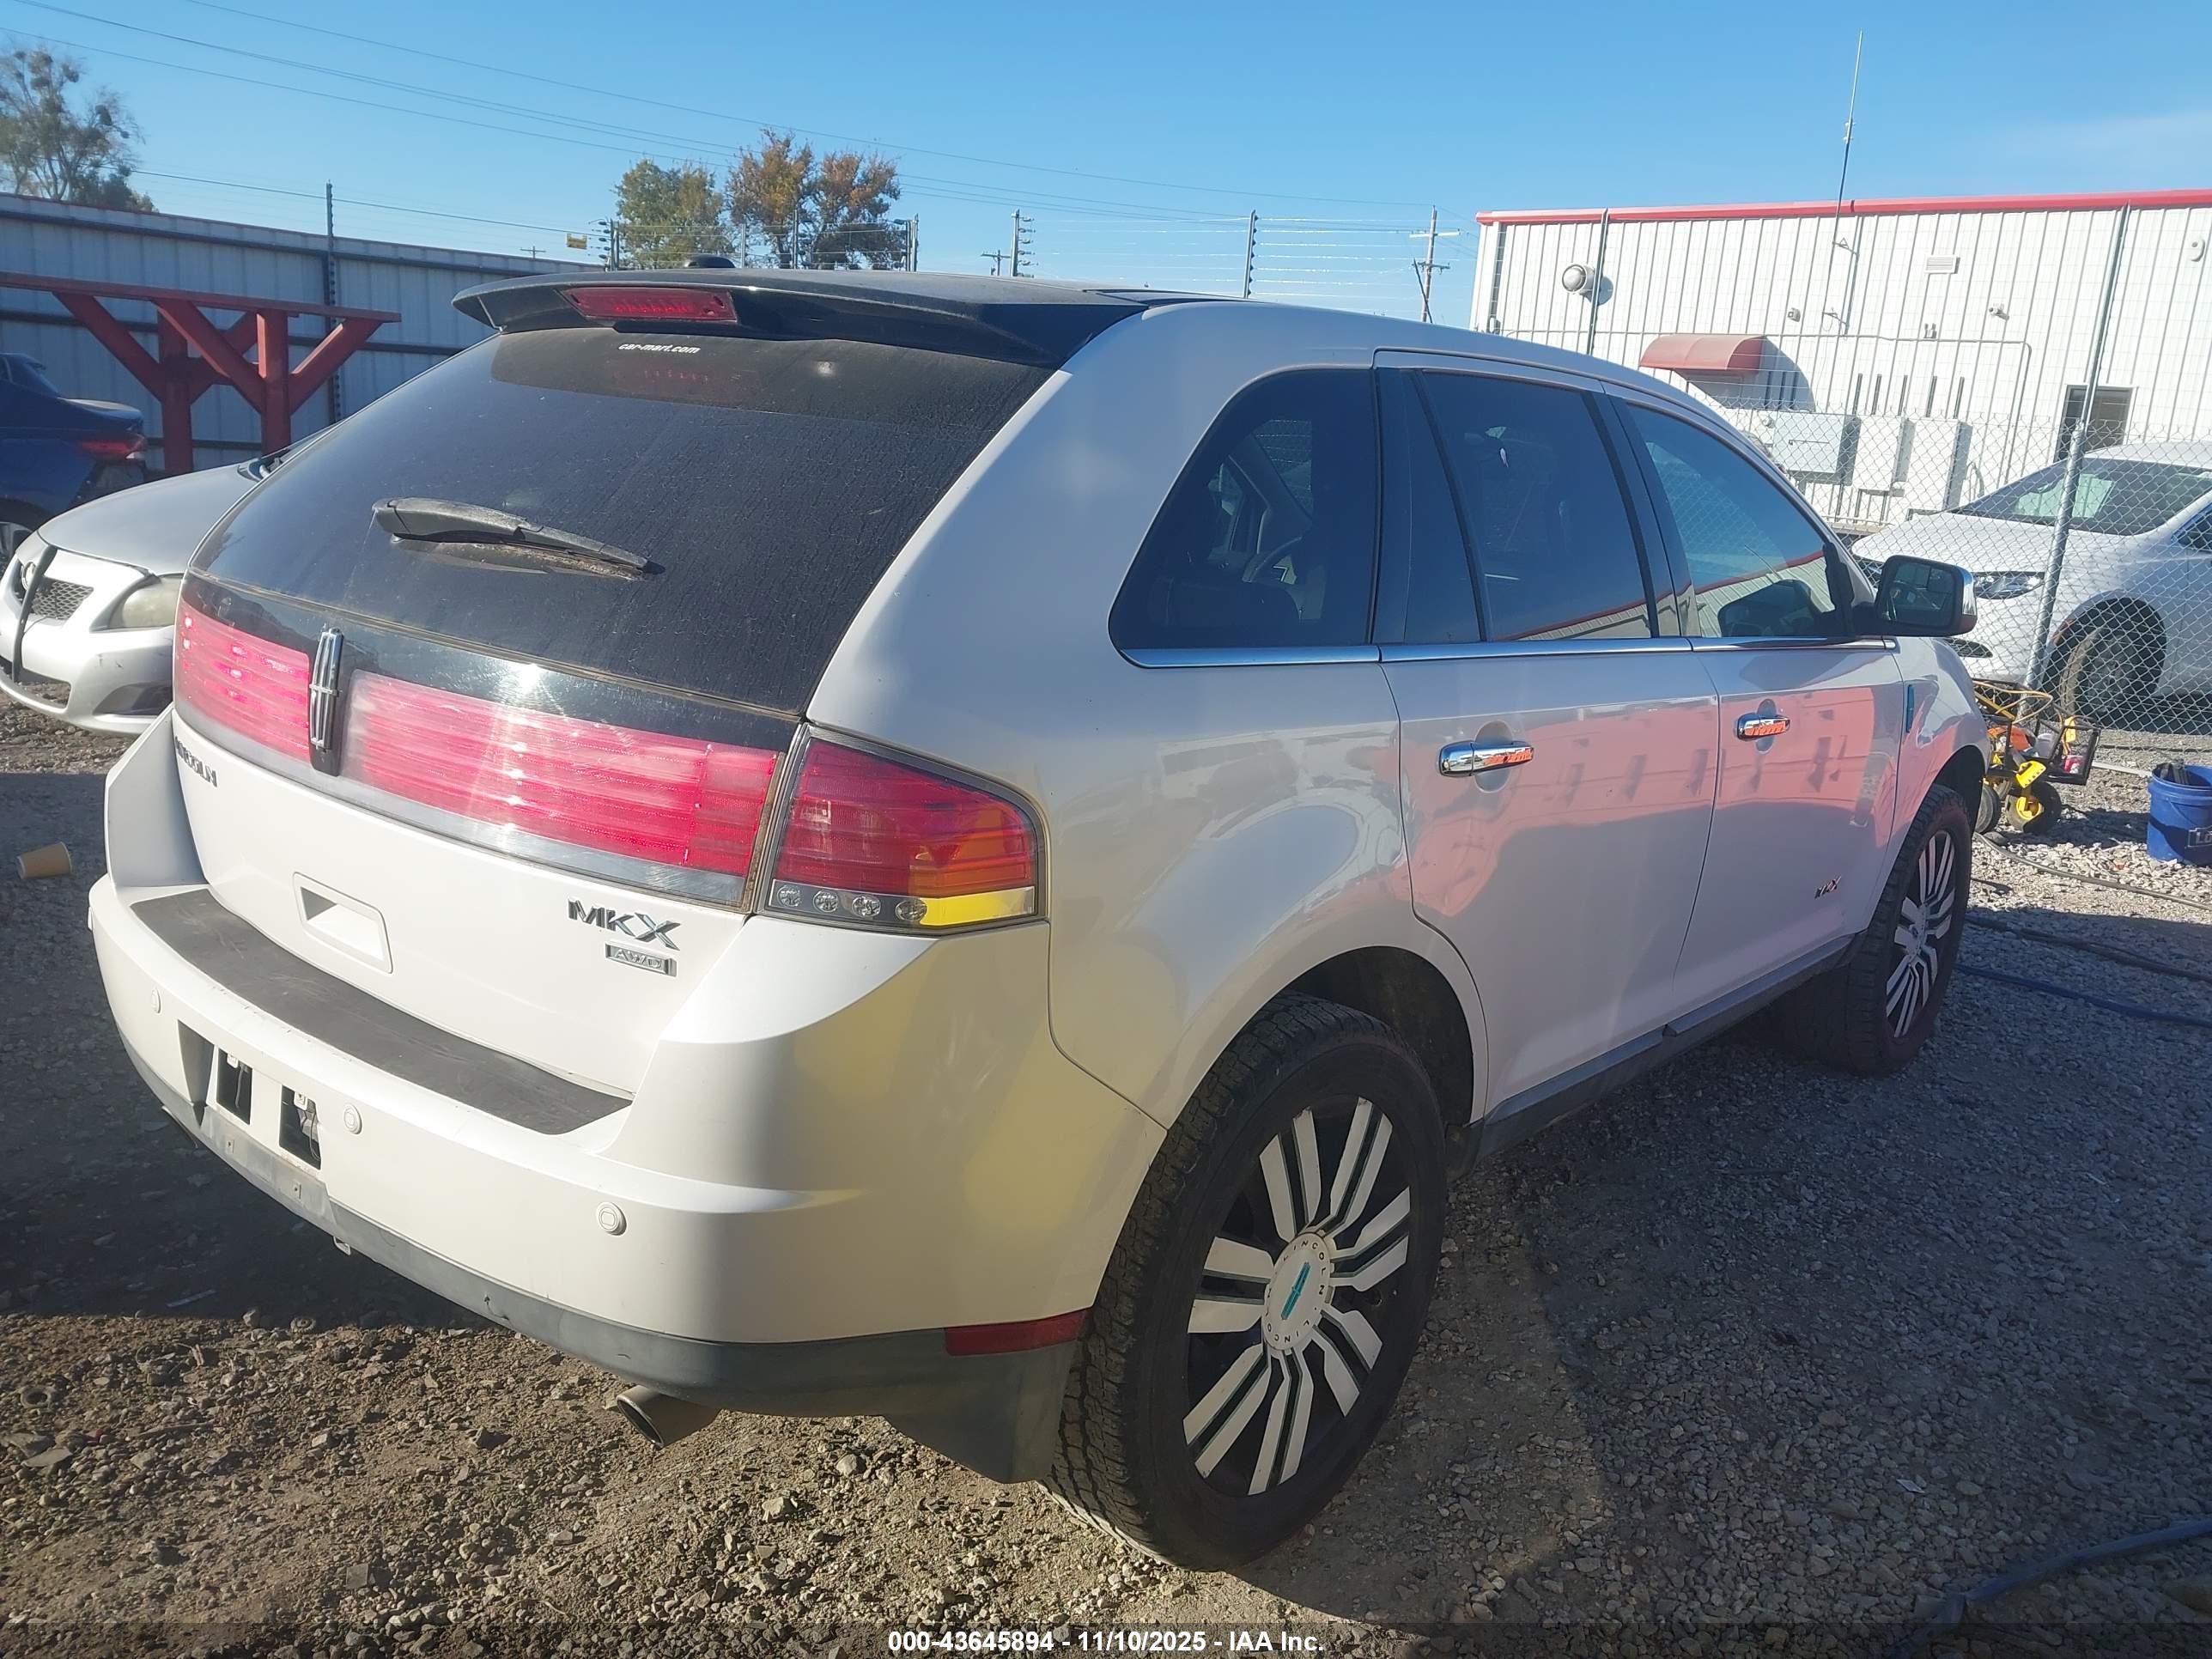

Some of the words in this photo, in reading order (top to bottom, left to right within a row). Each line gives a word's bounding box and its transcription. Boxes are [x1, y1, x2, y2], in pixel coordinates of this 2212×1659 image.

[618, 343, 701, 354] car-mart.com
[568, 900, 681, 951] MKX
[614, 948, 663, 969] AWD
[1283, 1240, 1326, 1295] LINCOLN
